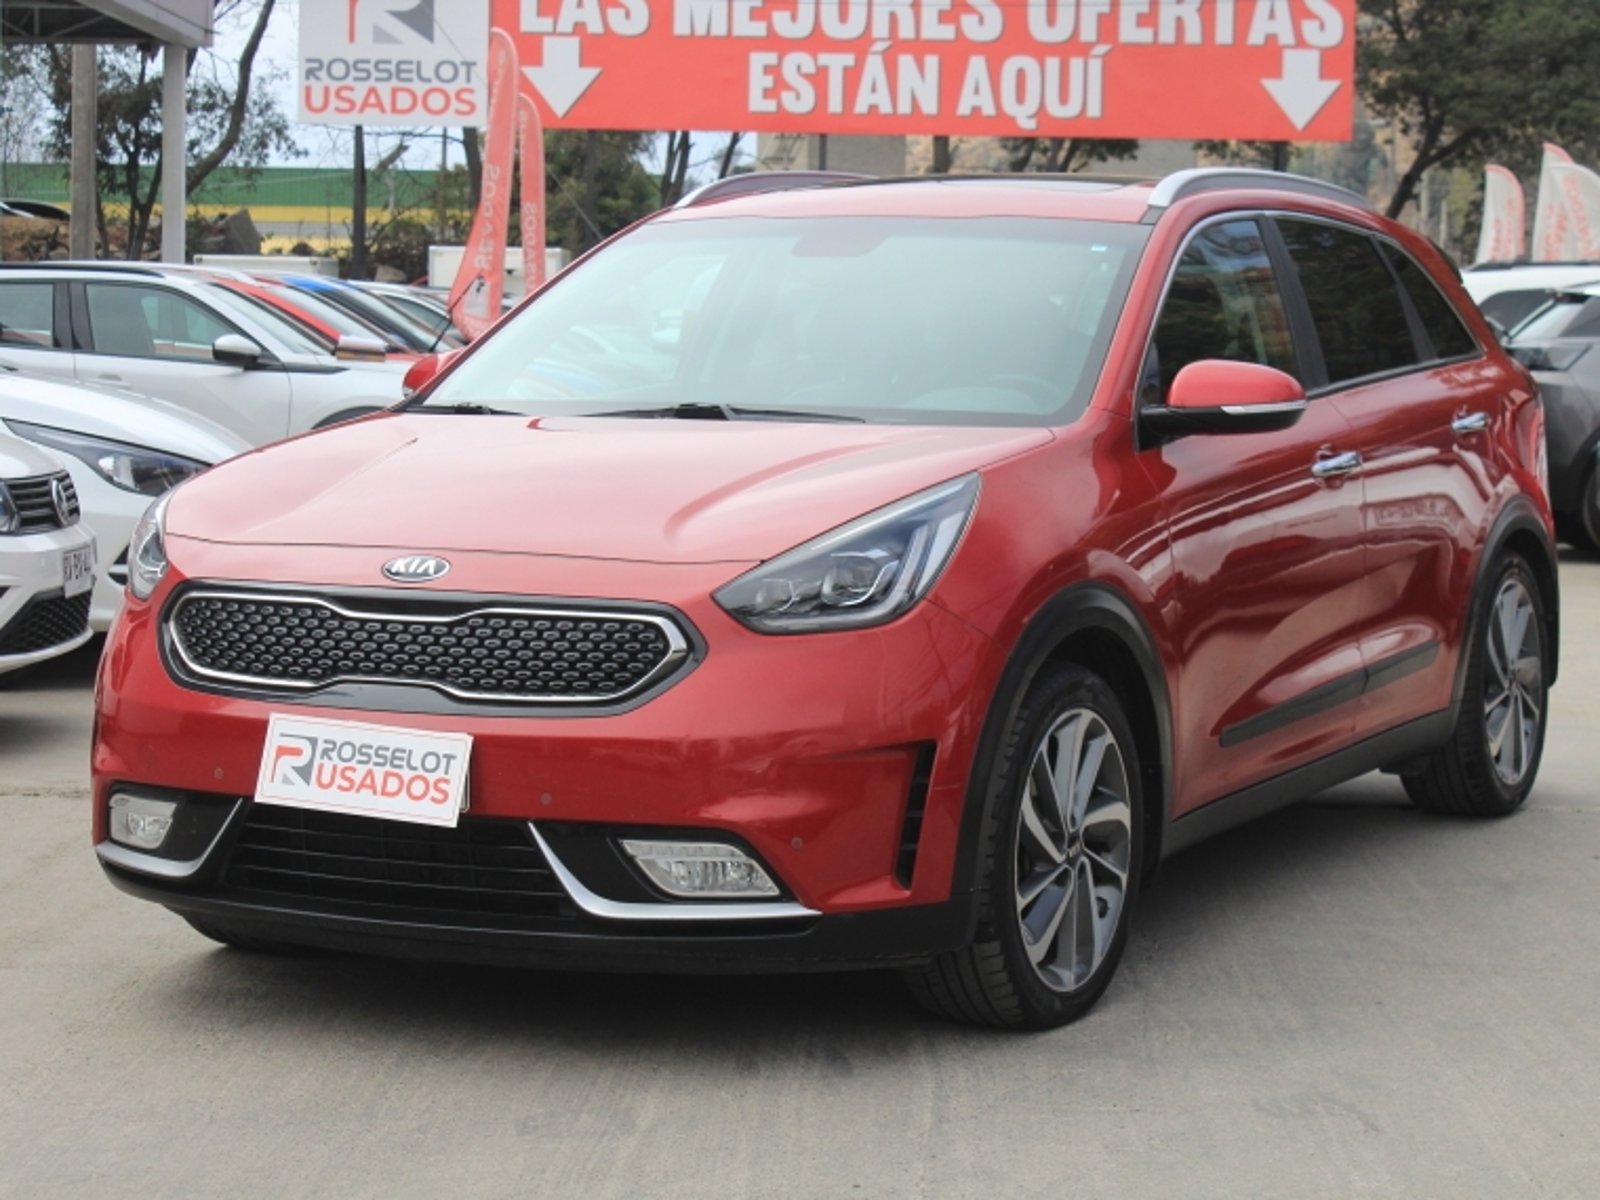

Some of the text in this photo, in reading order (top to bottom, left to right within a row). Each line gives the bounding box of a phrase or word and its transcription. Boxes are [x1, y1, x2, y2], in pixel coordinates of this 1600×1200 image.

[304, 57, 478, 84] ROSSELOT
[748, 41, 1111, 130] ESTÁN AQUÍ
[304, 84, 478, 117] USADOS
[391, 558, 437, 575] KIA
[319, 738, 457, 776] ROSSELOT
[314, 762, 451, 805] USADOS
